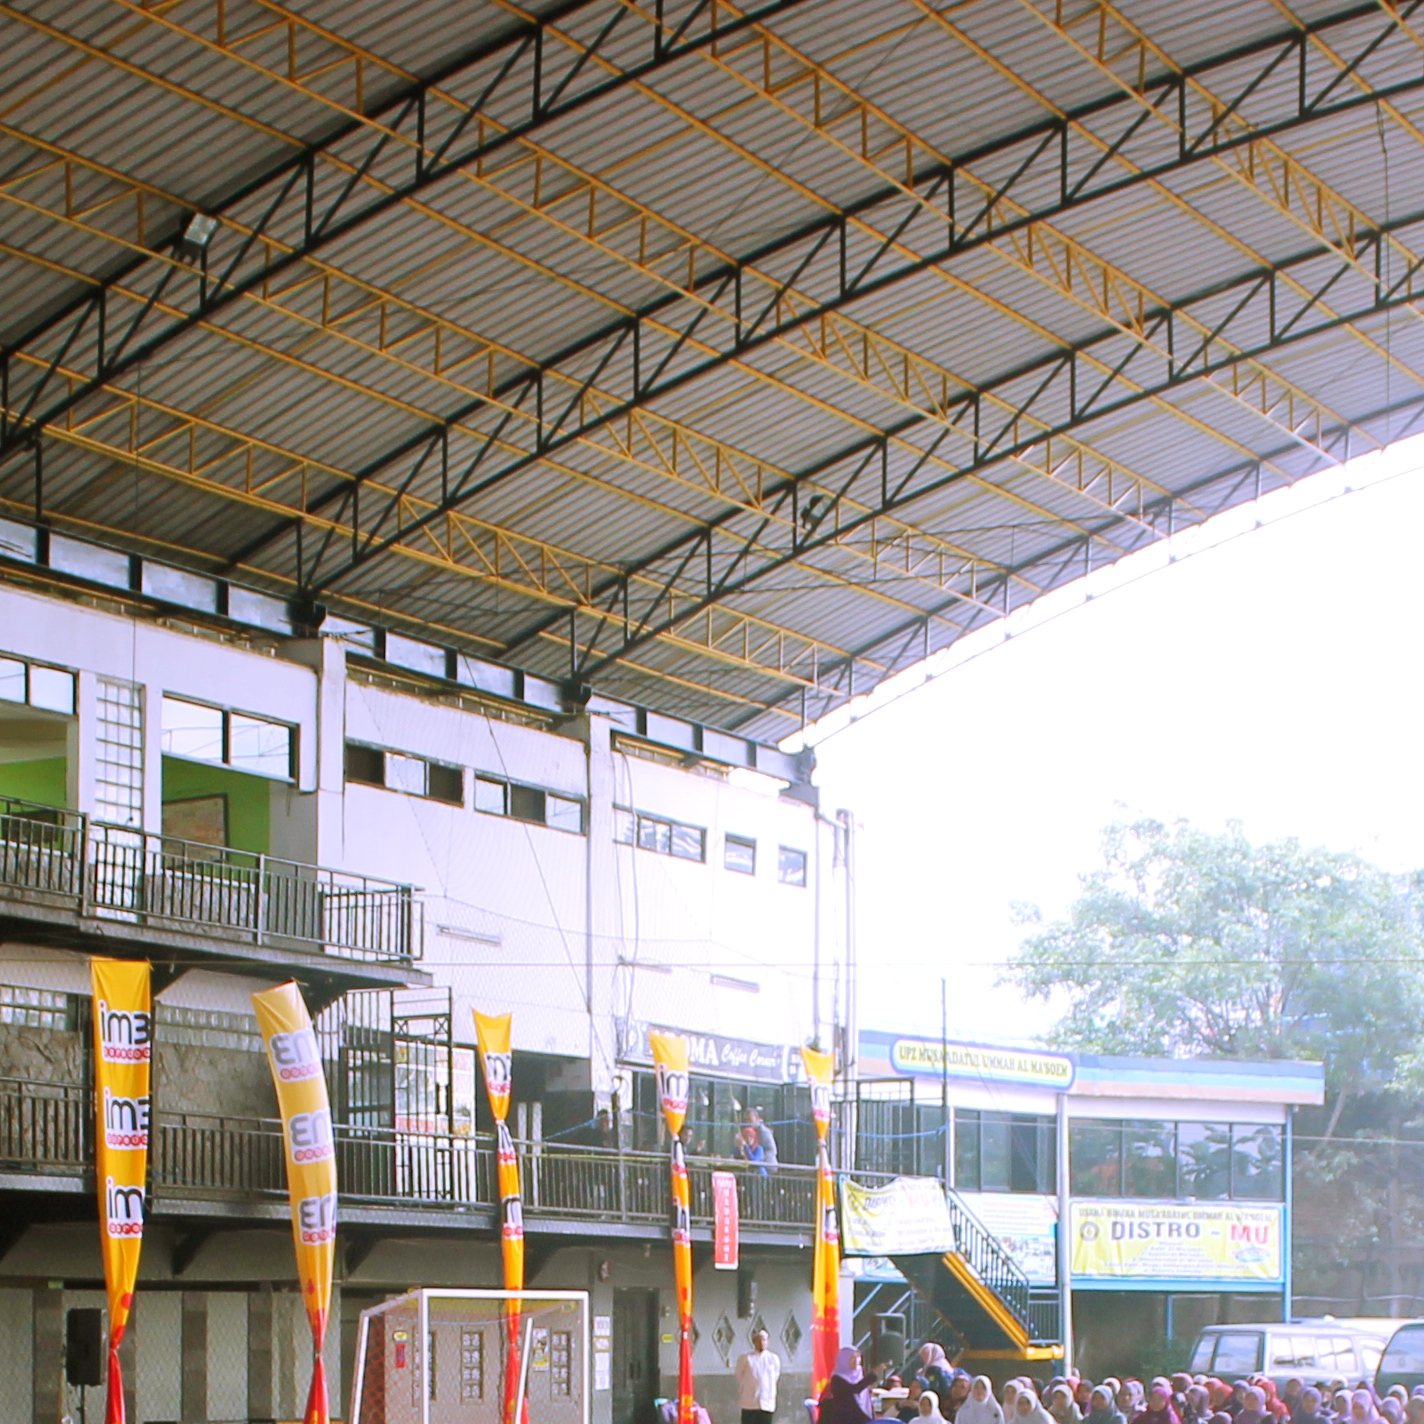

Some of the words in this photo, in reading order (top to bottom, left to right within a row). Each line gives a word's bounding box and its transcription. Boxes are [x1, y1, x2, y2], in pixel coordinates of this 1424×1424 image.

[99, 1001, 150, 1045] im3
[898, 1045, 917, 1061] UPZ
[918, 1047, 981, 1069] MUSAADATUL
[1016, 1058, 1029, 1073] AL
[1110, 1220, 1201, 1241] DISTRO
[1230, 1223, 1270, 1245] MU
